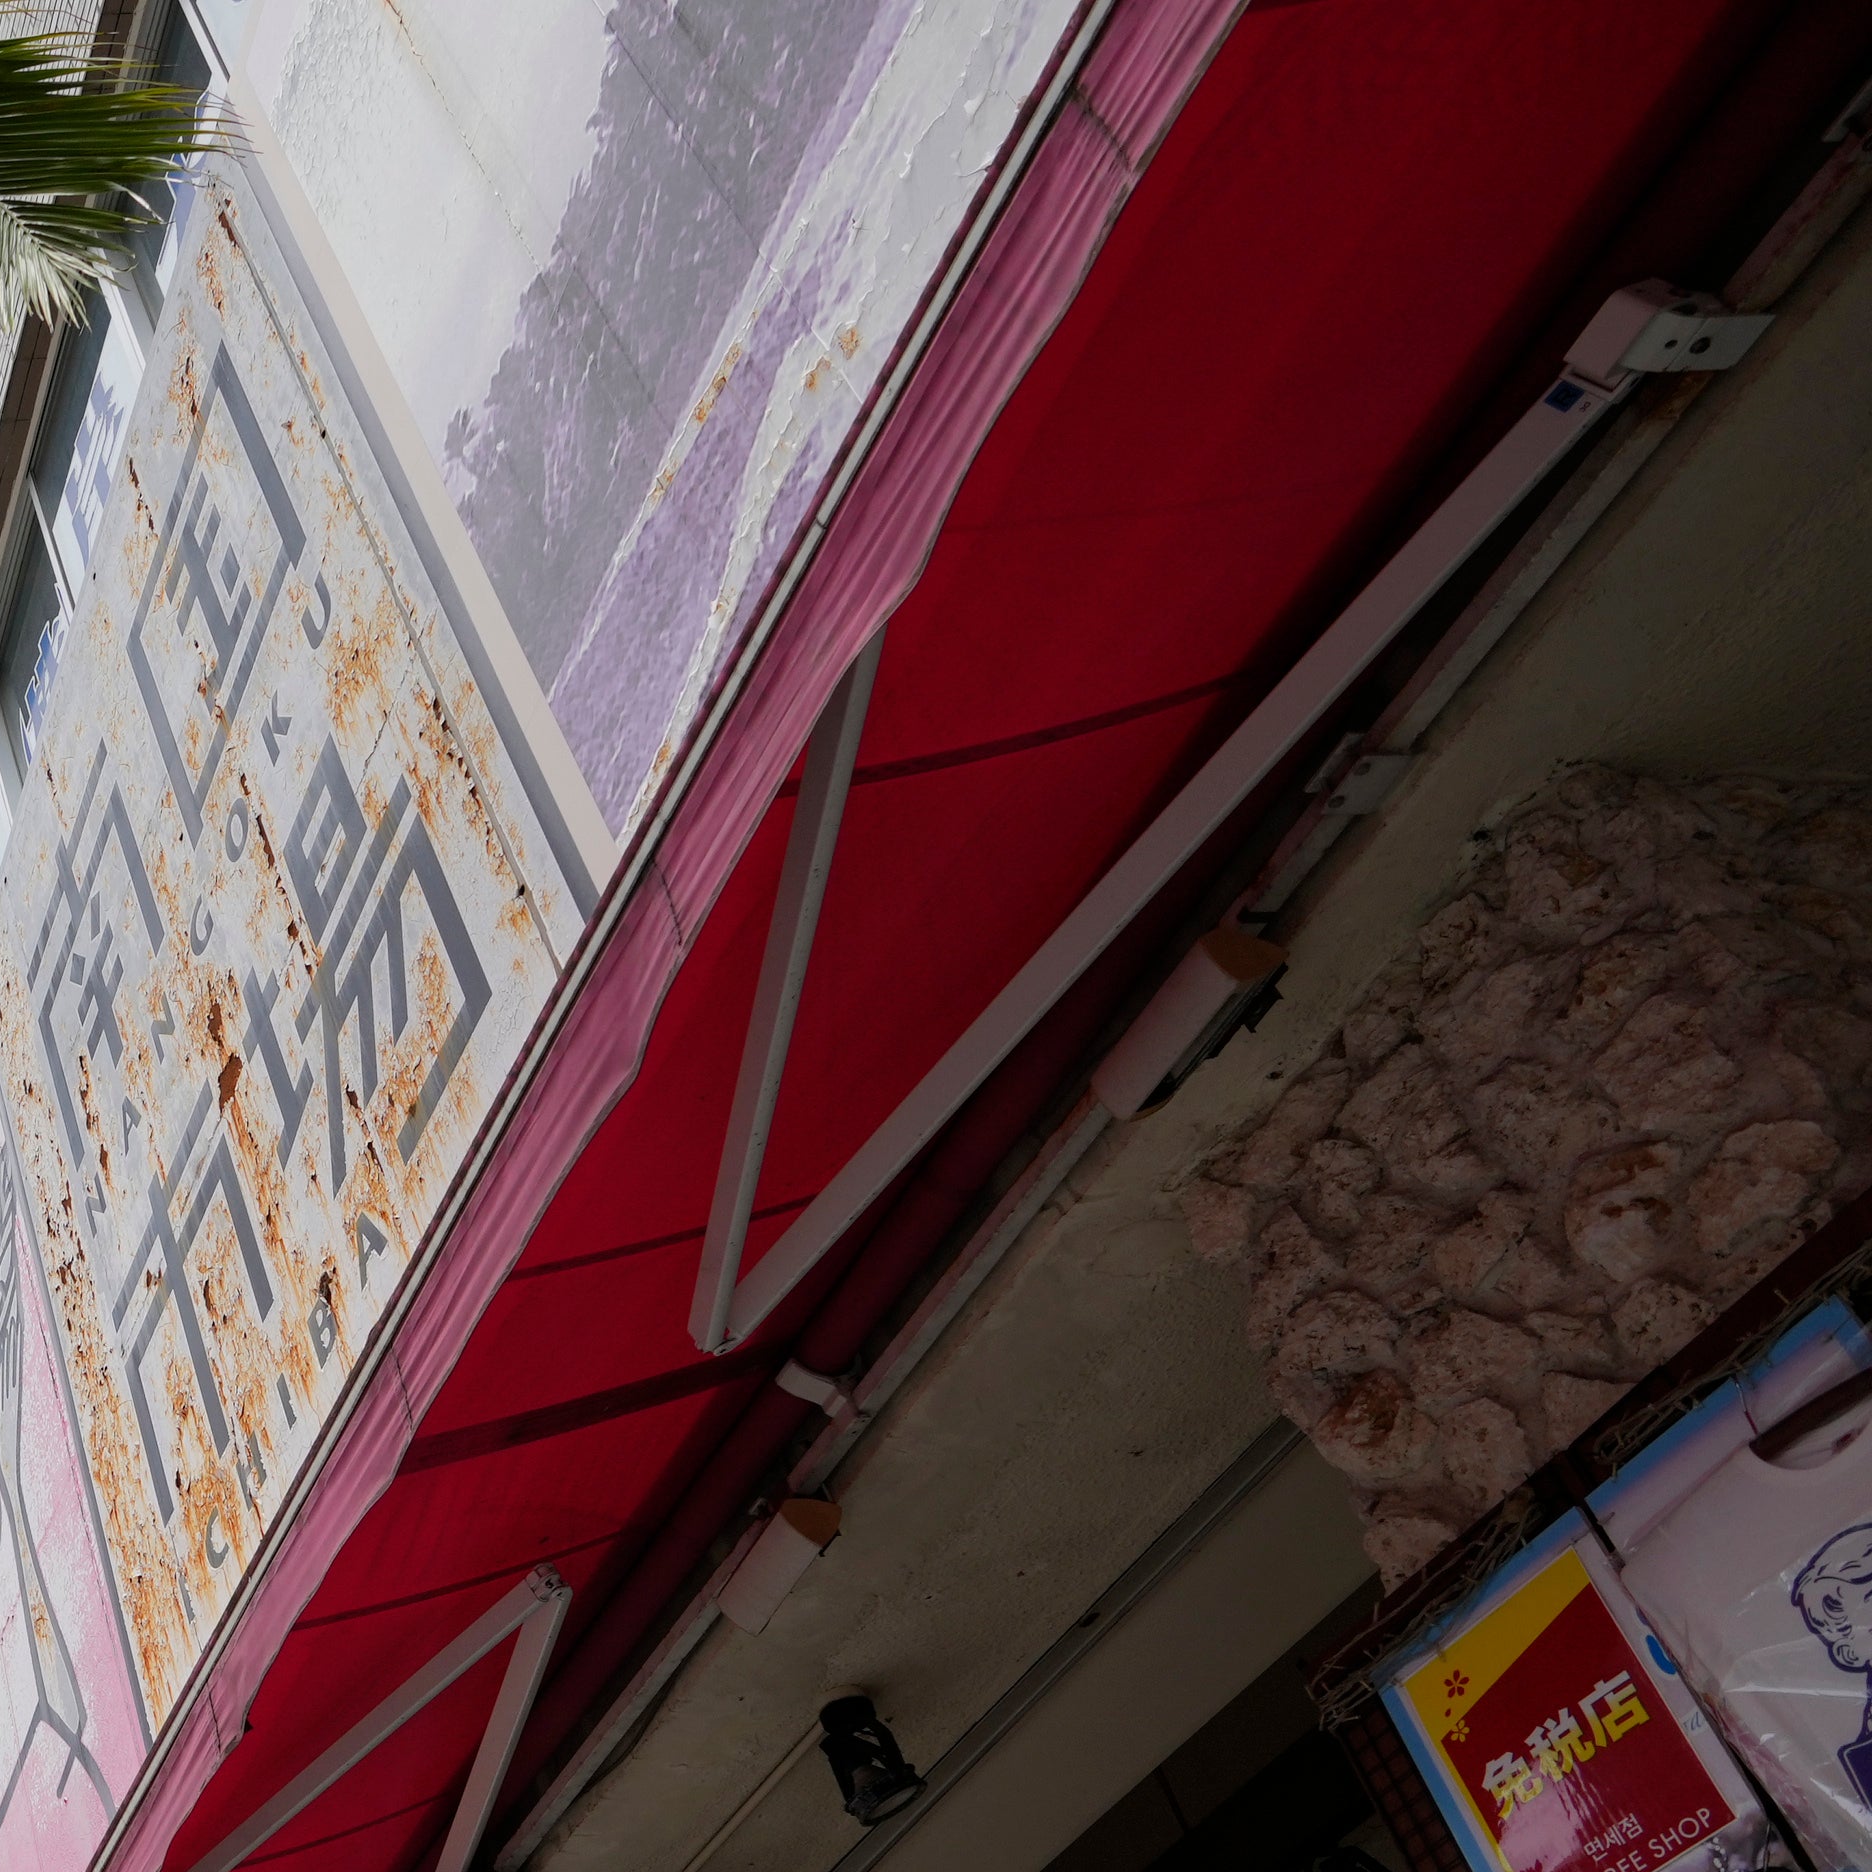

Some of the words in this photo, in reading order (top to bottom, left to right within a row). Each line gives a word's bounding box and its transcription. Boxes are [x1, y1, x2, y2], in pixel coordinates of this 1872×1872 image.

[1481, 1669, 1650, 1820] 免税店
[1584, 1813, 1643, 1863] 면세점
[1648, 1807, 1711, 1859] SHOP
